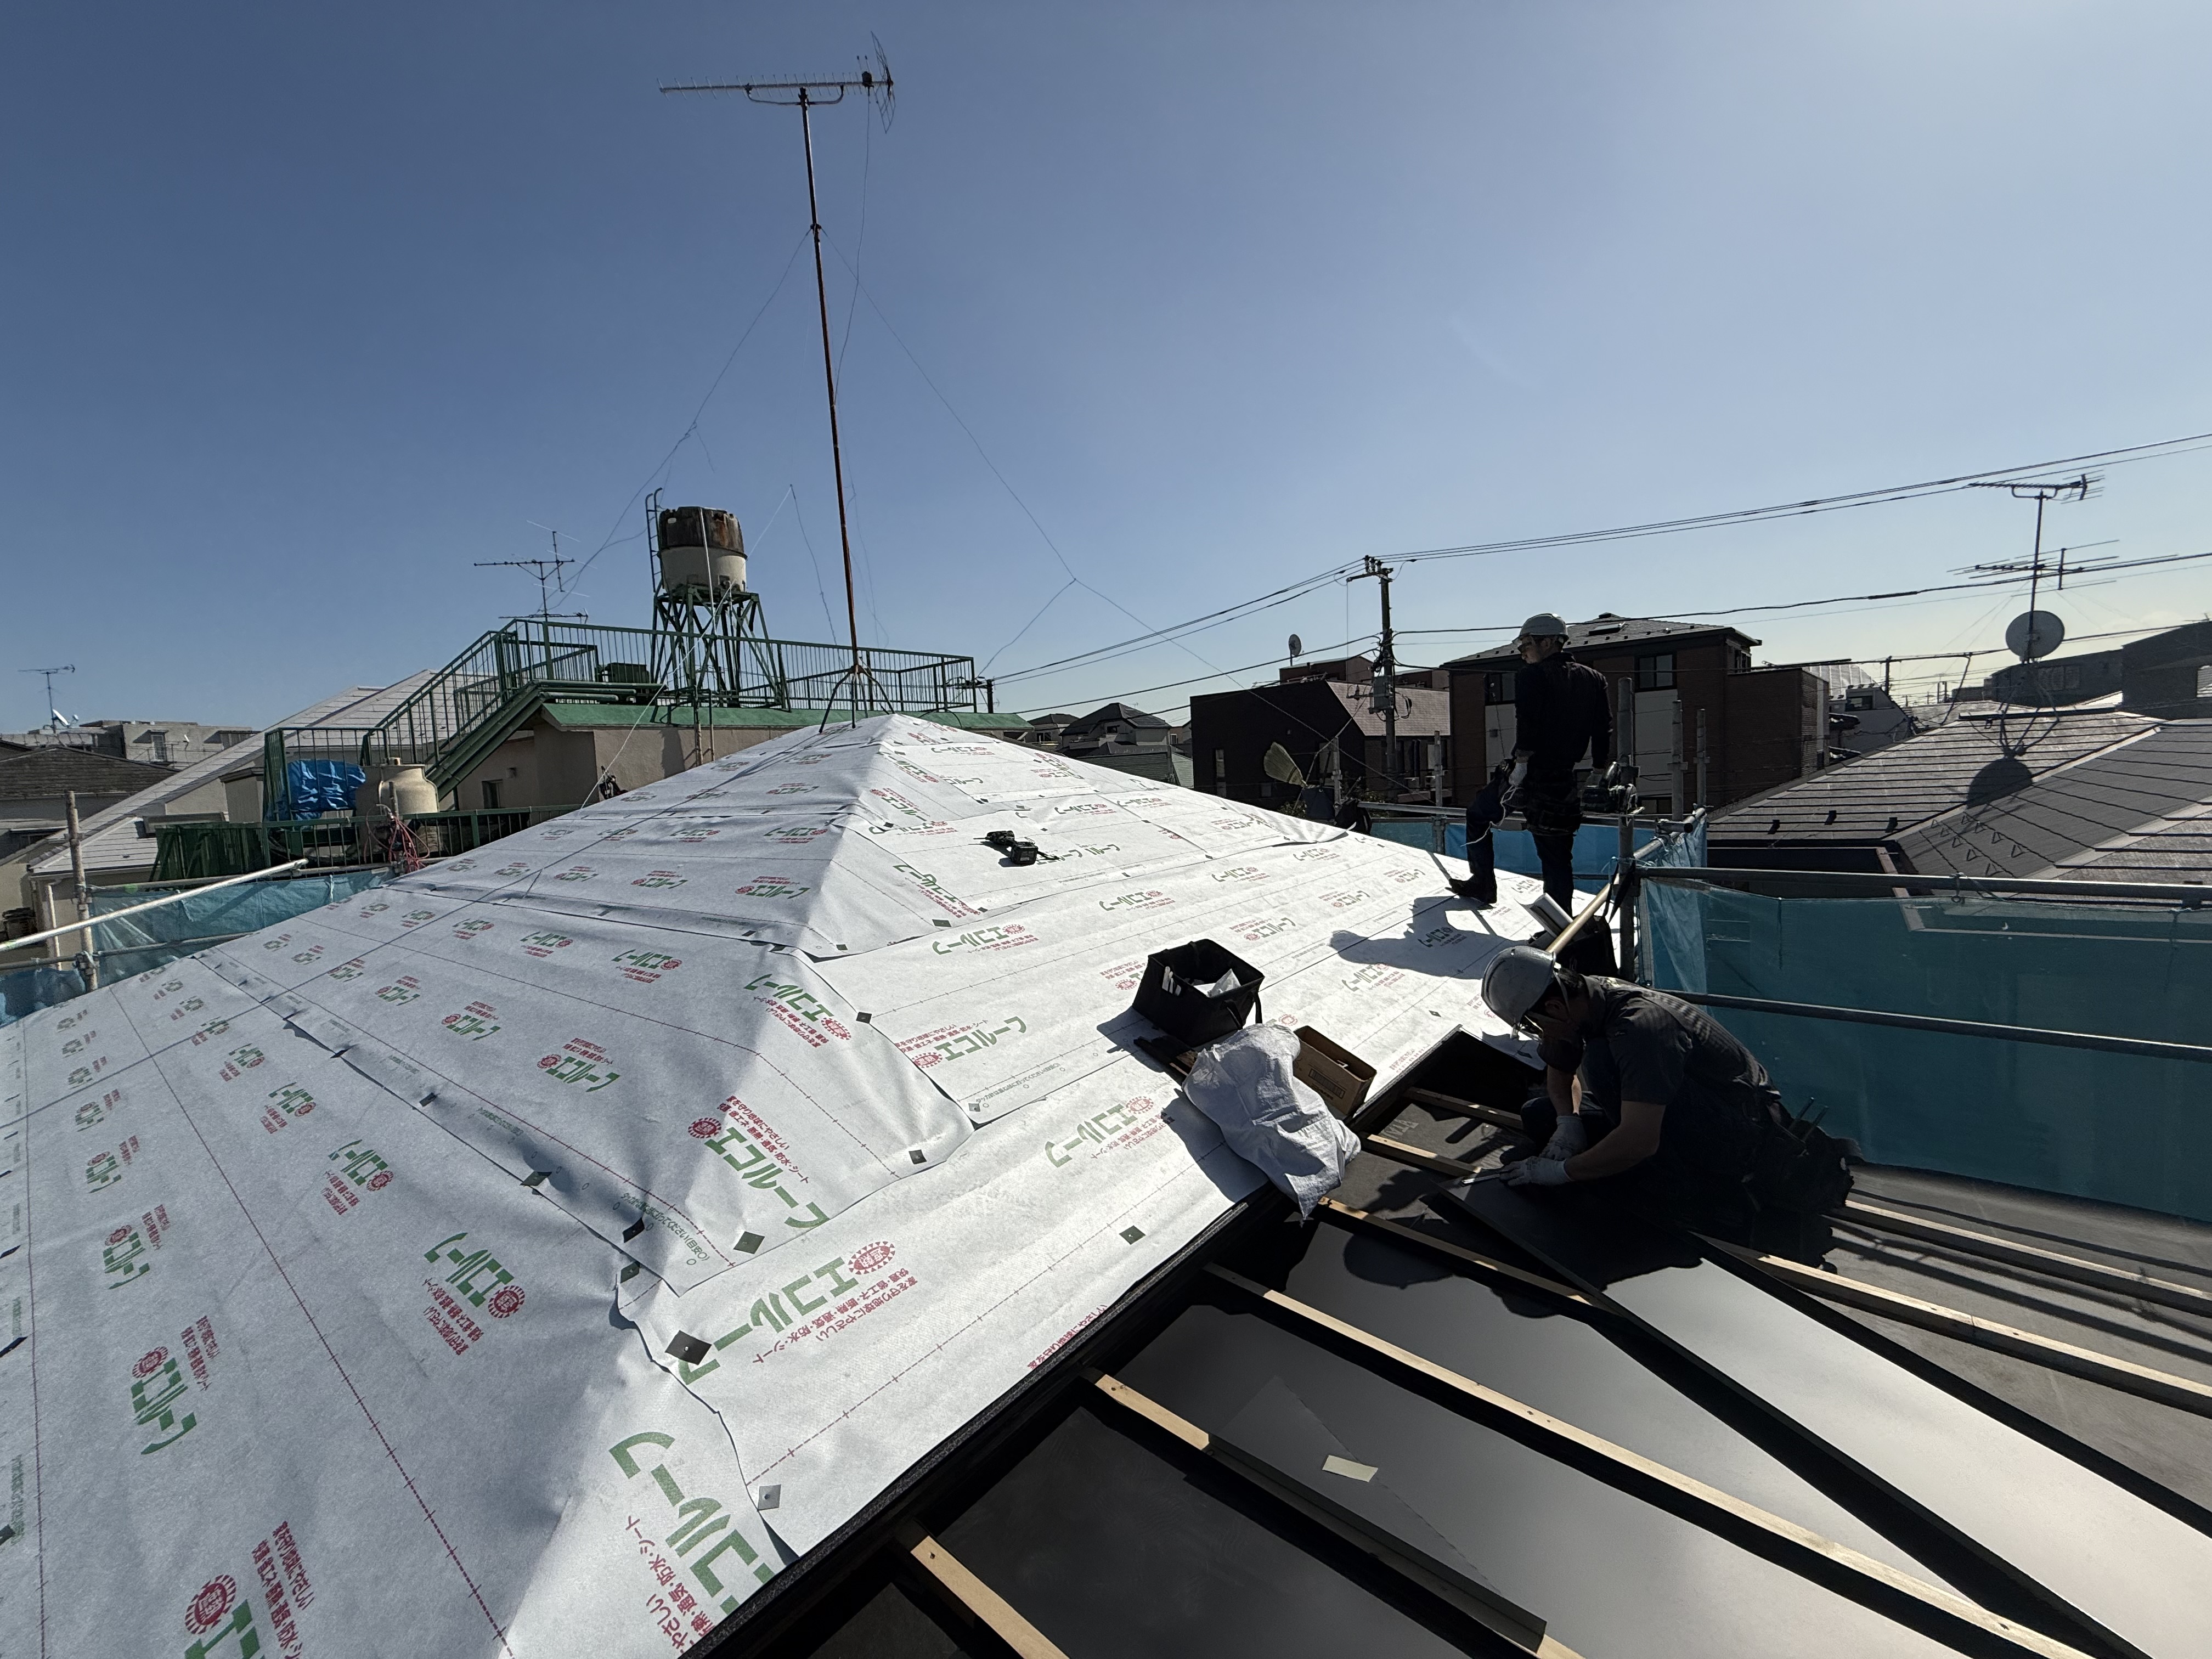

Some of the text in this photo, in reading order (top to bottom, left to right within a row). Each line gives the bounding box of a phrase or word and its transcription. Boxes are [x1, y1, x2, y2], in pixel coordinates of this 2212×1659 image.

[933, 926, 1009, 955] エコルーフ
[744, 974, 834, 1023] エコルーフ
[933, 1016, 1027, 1061] エコルーフ
[1045, 1103, 1138, 1168] エコルーフ
[704, 1126, 830, 1228] エコルーフ
[424, 1232, 515, 1307] エコルーフ
[752, 1268, 910, 1364] 快適・省エネ・断熱・通気・防水・シート
[815, 1274, 918, 1342] 家を守り地球にやさしい
